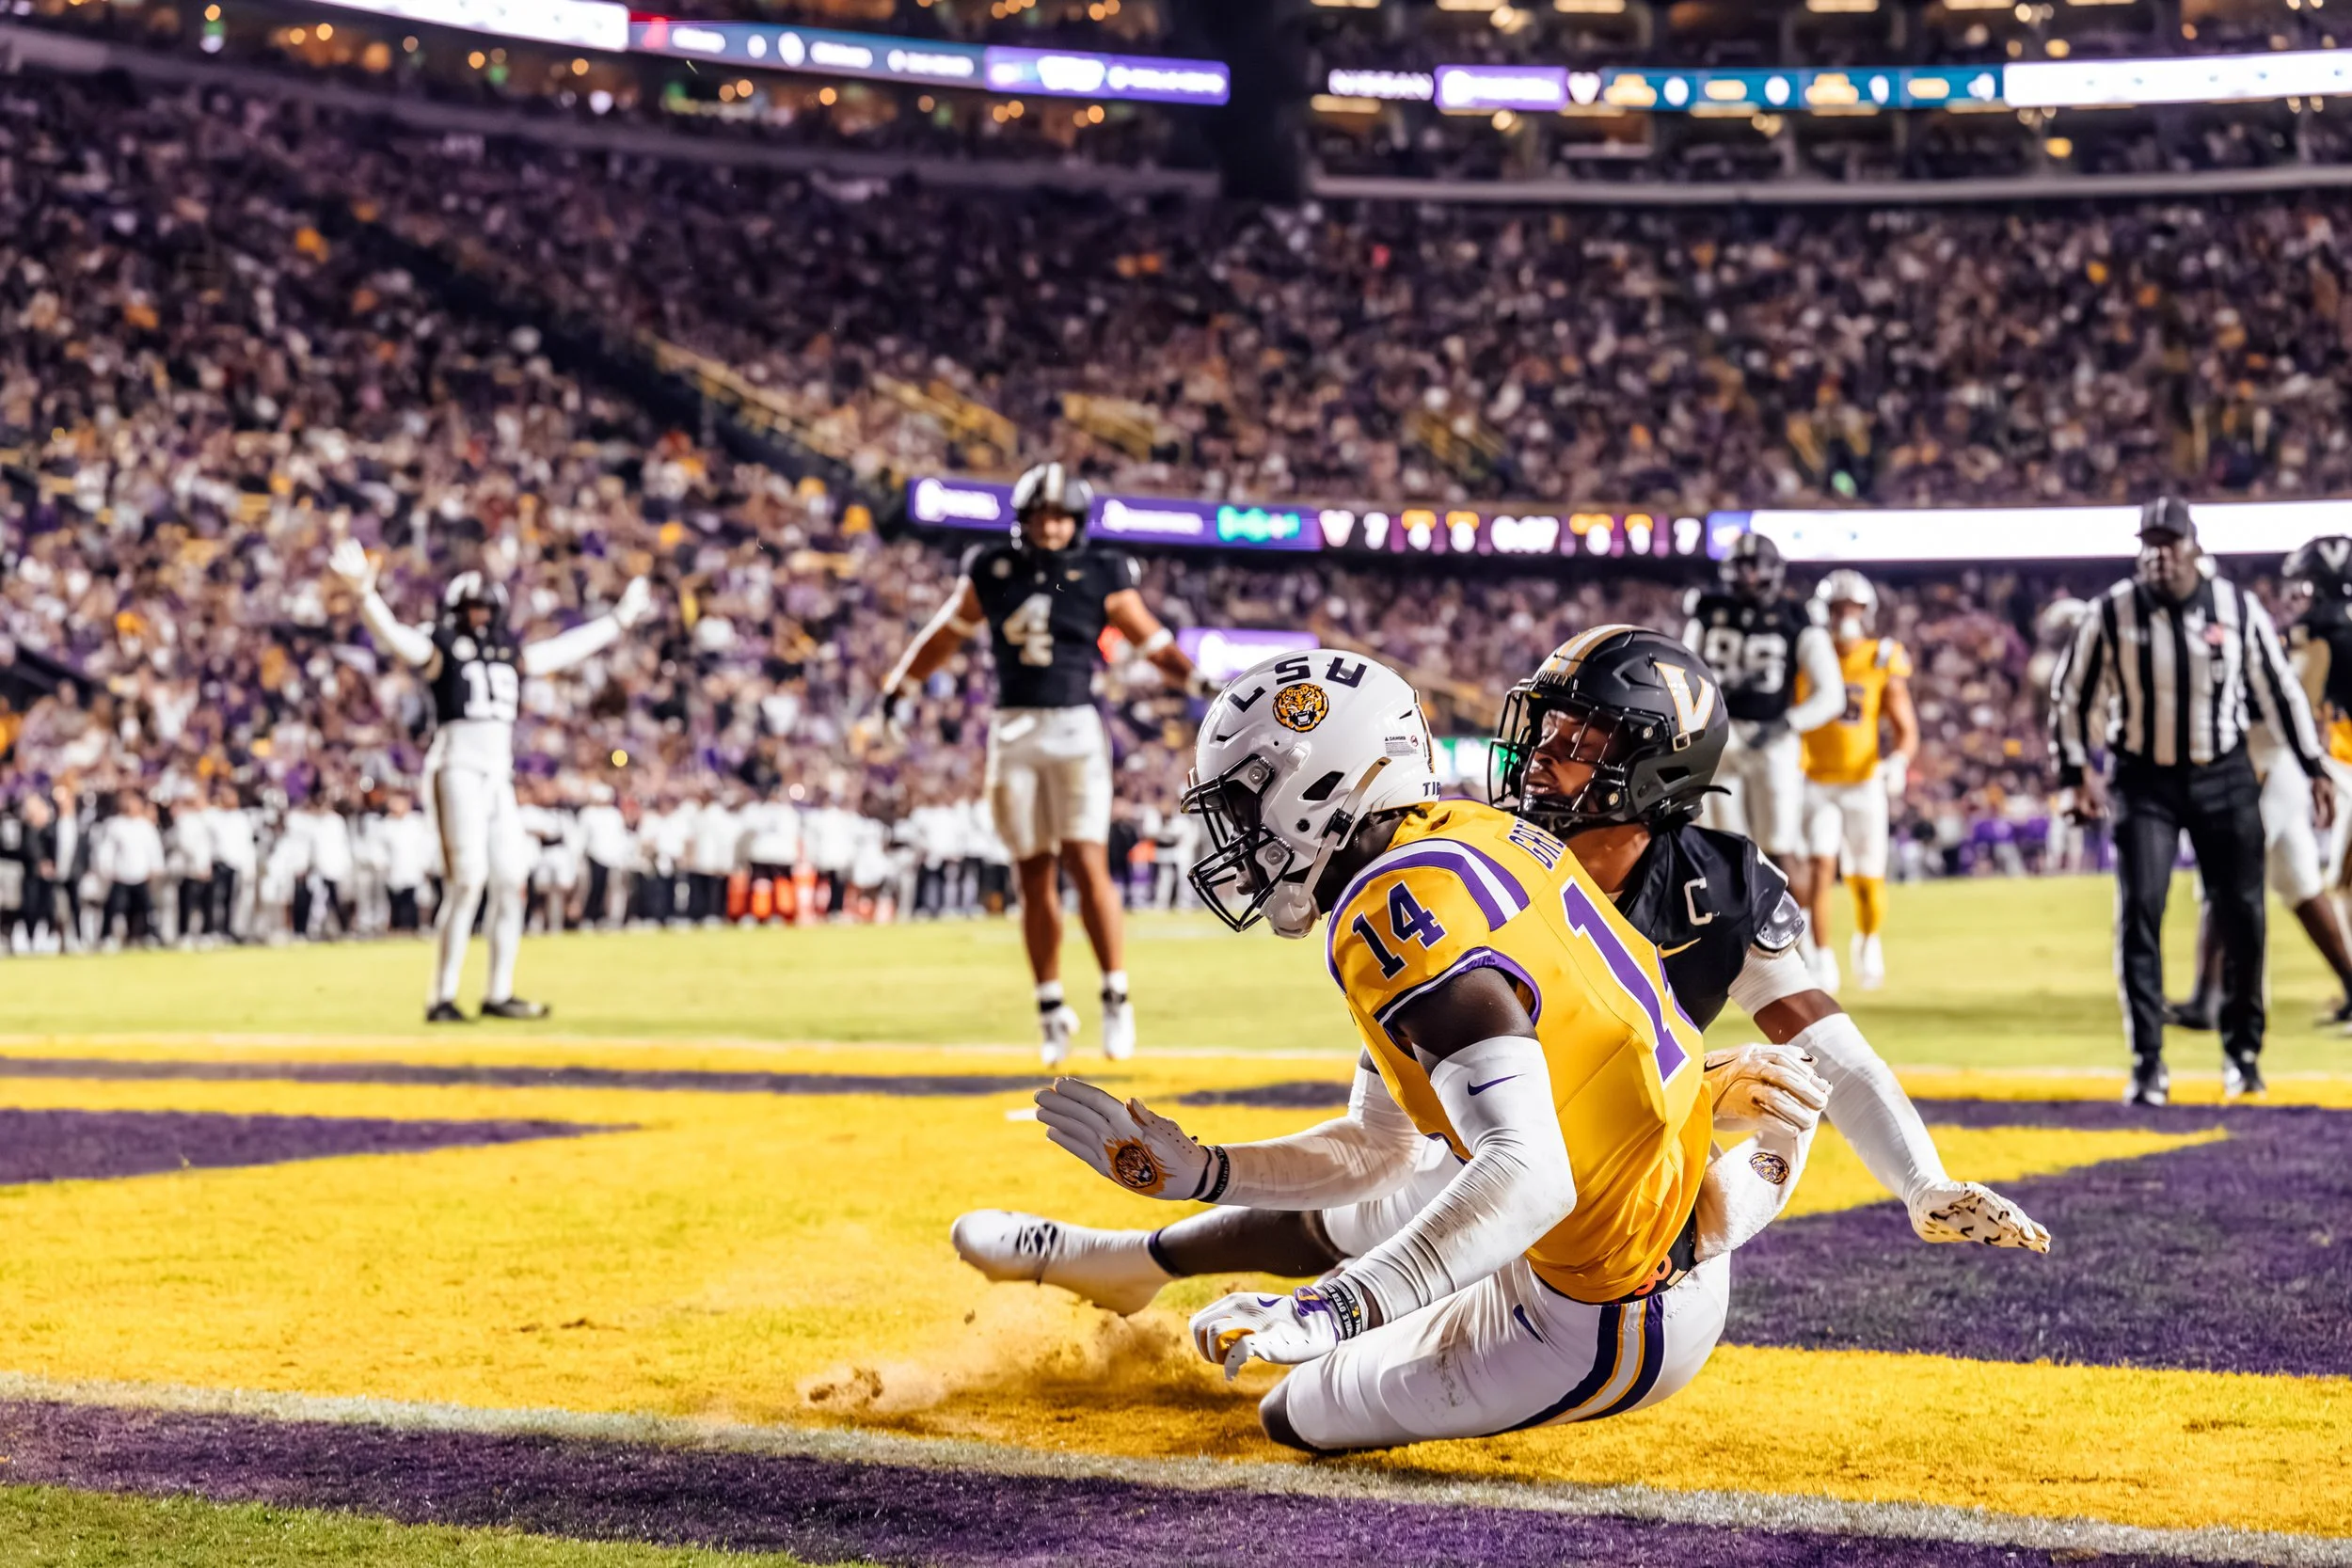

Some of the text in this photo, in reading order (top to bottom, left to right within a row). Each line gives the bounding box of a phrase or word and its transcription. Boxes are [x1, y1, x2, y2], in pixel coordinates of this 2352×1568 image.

[1003, 593, 1054, 666] 4
[1229, 657, 1367, 713] LSU
[1654, 661, 1716, 733] V
[1352, 880, 1447, 980] 14
[1683, 877, 1713, 927] C
